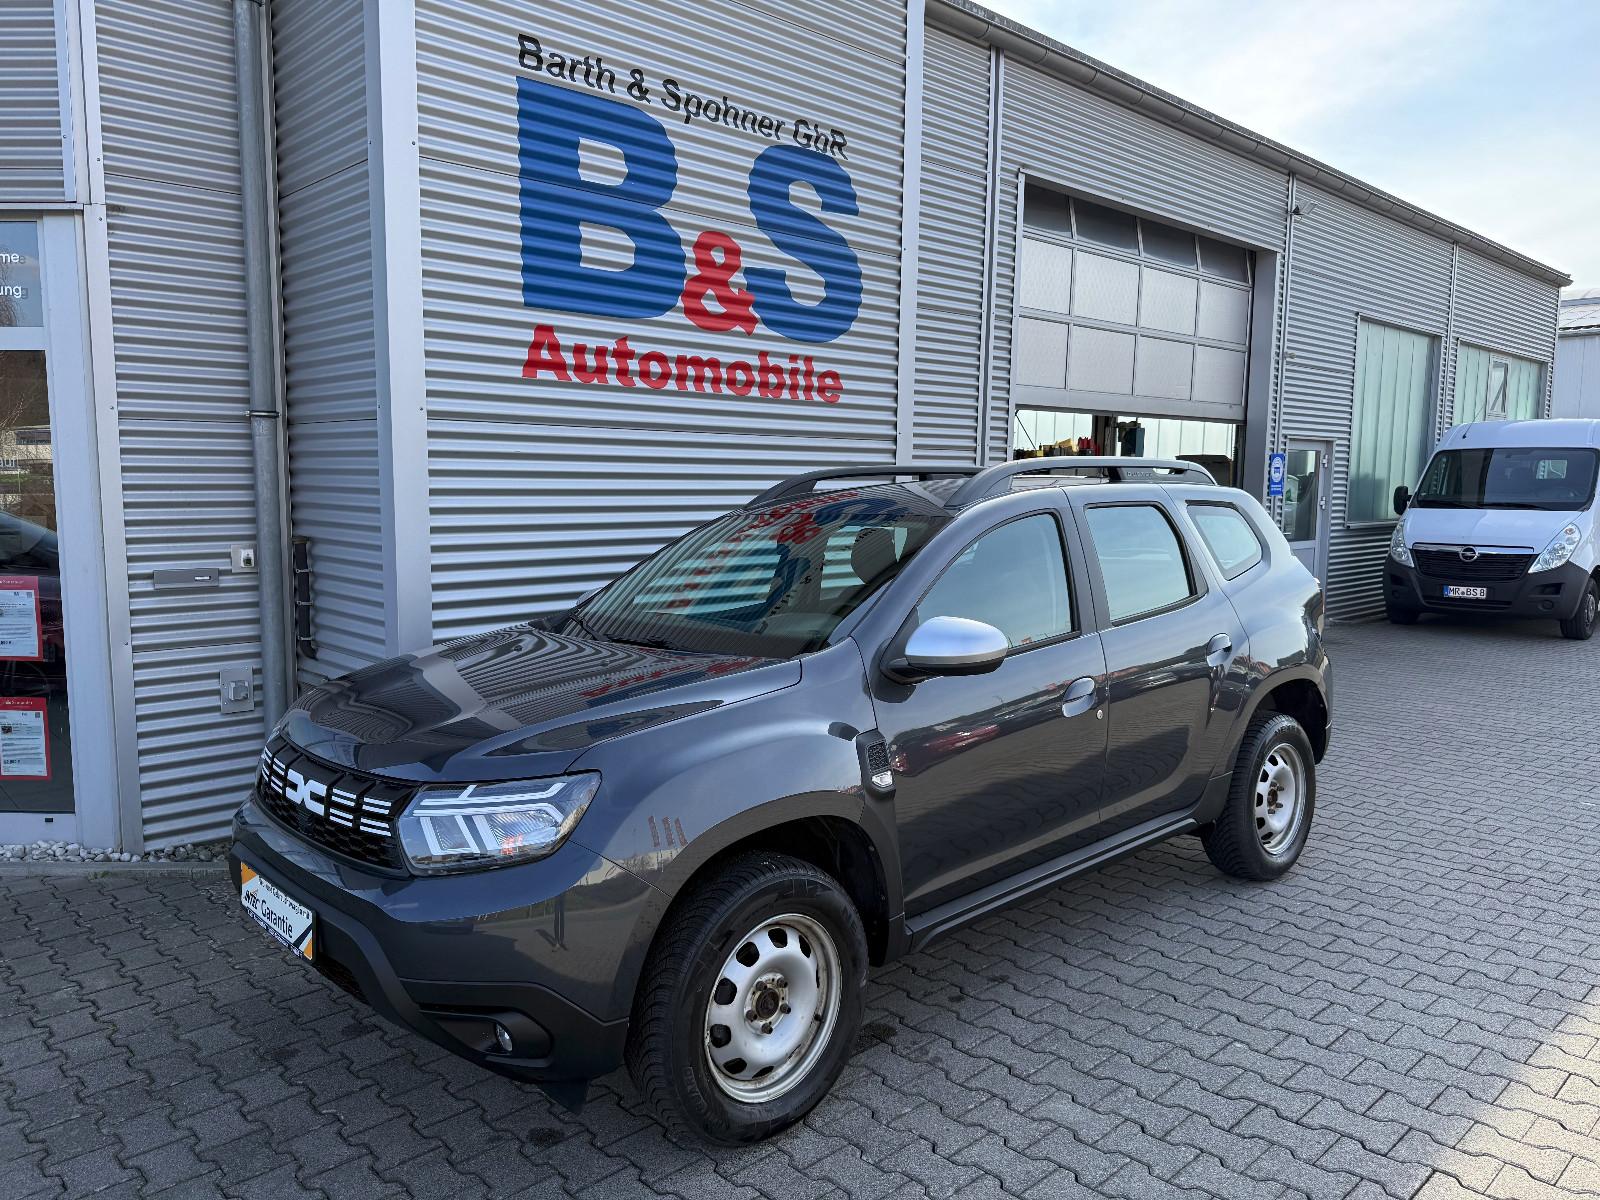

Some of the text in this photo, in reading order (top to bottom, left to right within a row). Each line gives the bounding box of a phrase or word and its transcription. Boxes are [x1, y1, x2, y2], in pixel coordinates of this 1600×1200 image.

[518, 33, 849, 161] Barth & Spohner GbR
[515, 75, 864, 344] B&S
[521, 324, 844, 404] Automobile
[1466, 588, 1478, 597] BS
[260, 899, 293, 939] Garantie
